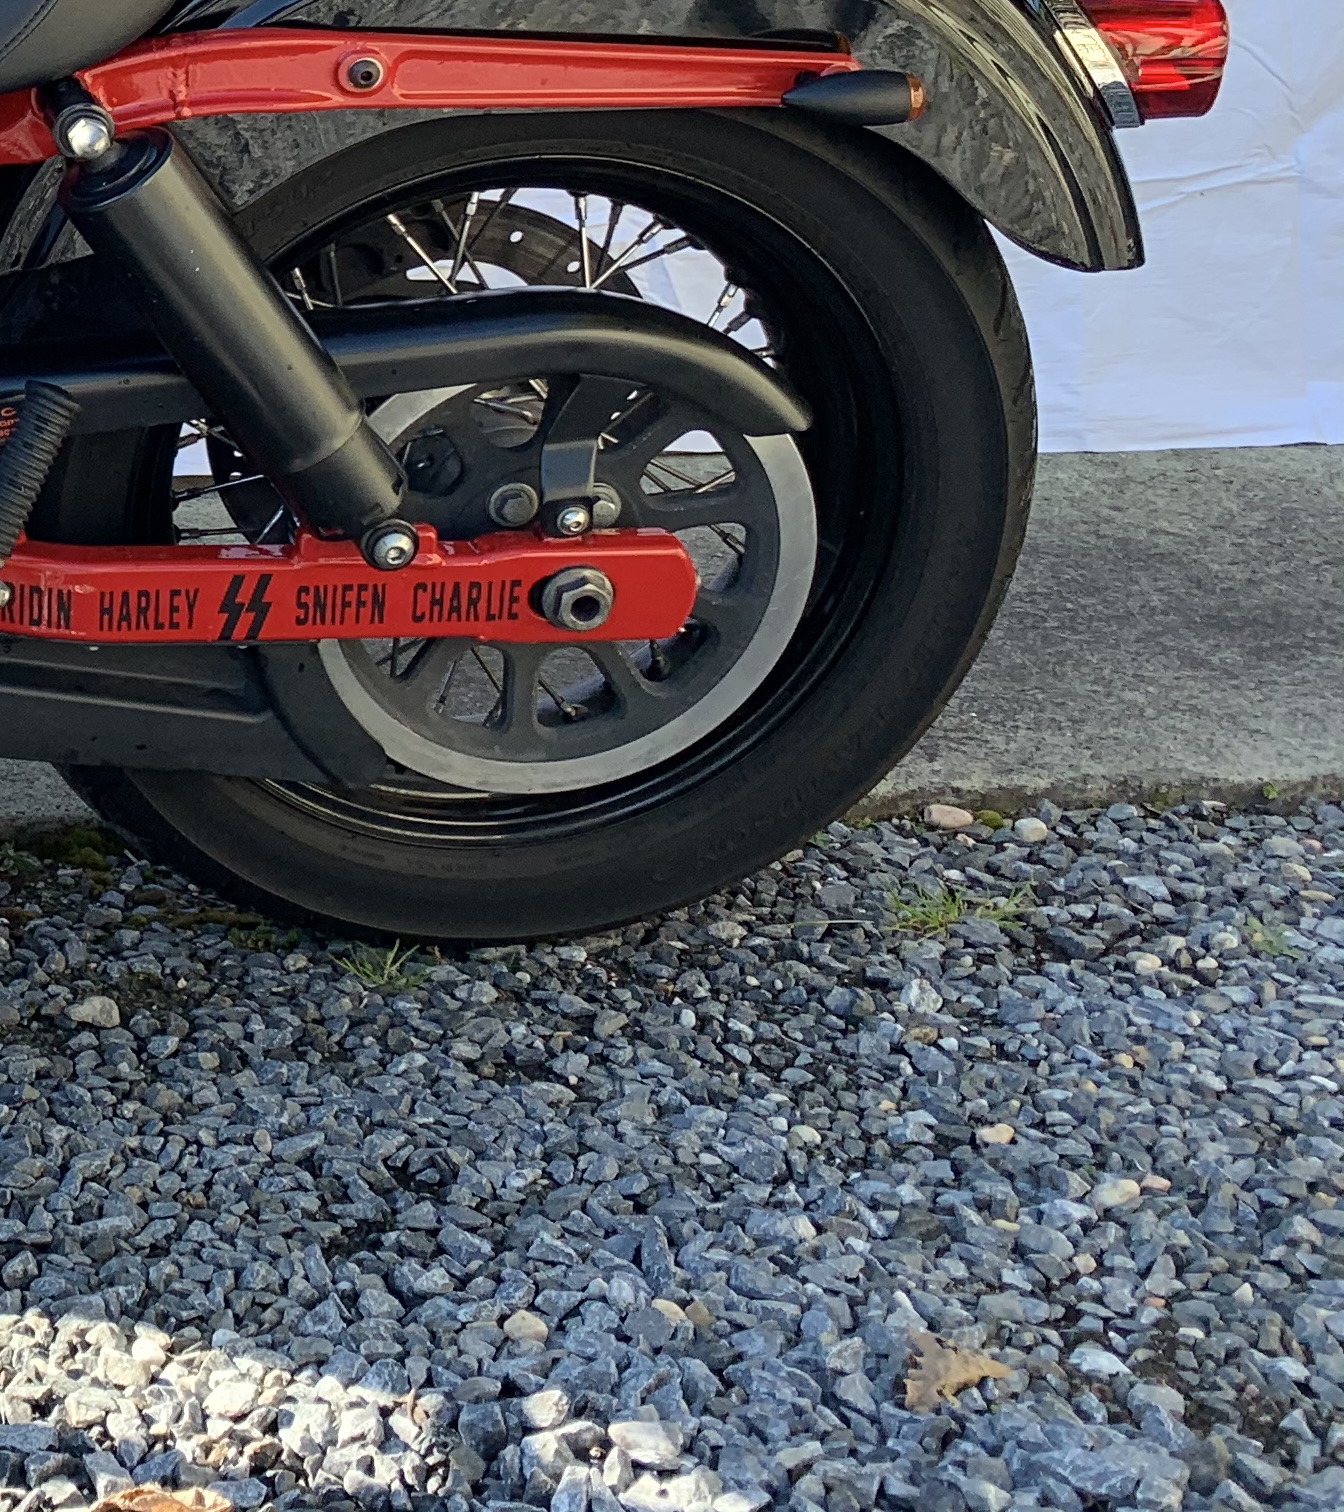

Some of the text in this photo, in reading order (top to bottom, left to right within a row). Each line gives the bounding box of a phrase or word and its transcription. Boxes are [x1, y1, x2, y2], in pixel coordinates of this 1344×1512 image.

[0, 581, 72, 630] RIDIN
[98, 587, 200, 632] HARLEY
[295, 583, 387, 626] SNIFFN
[412, 579, 522, 624] CHARLIE
